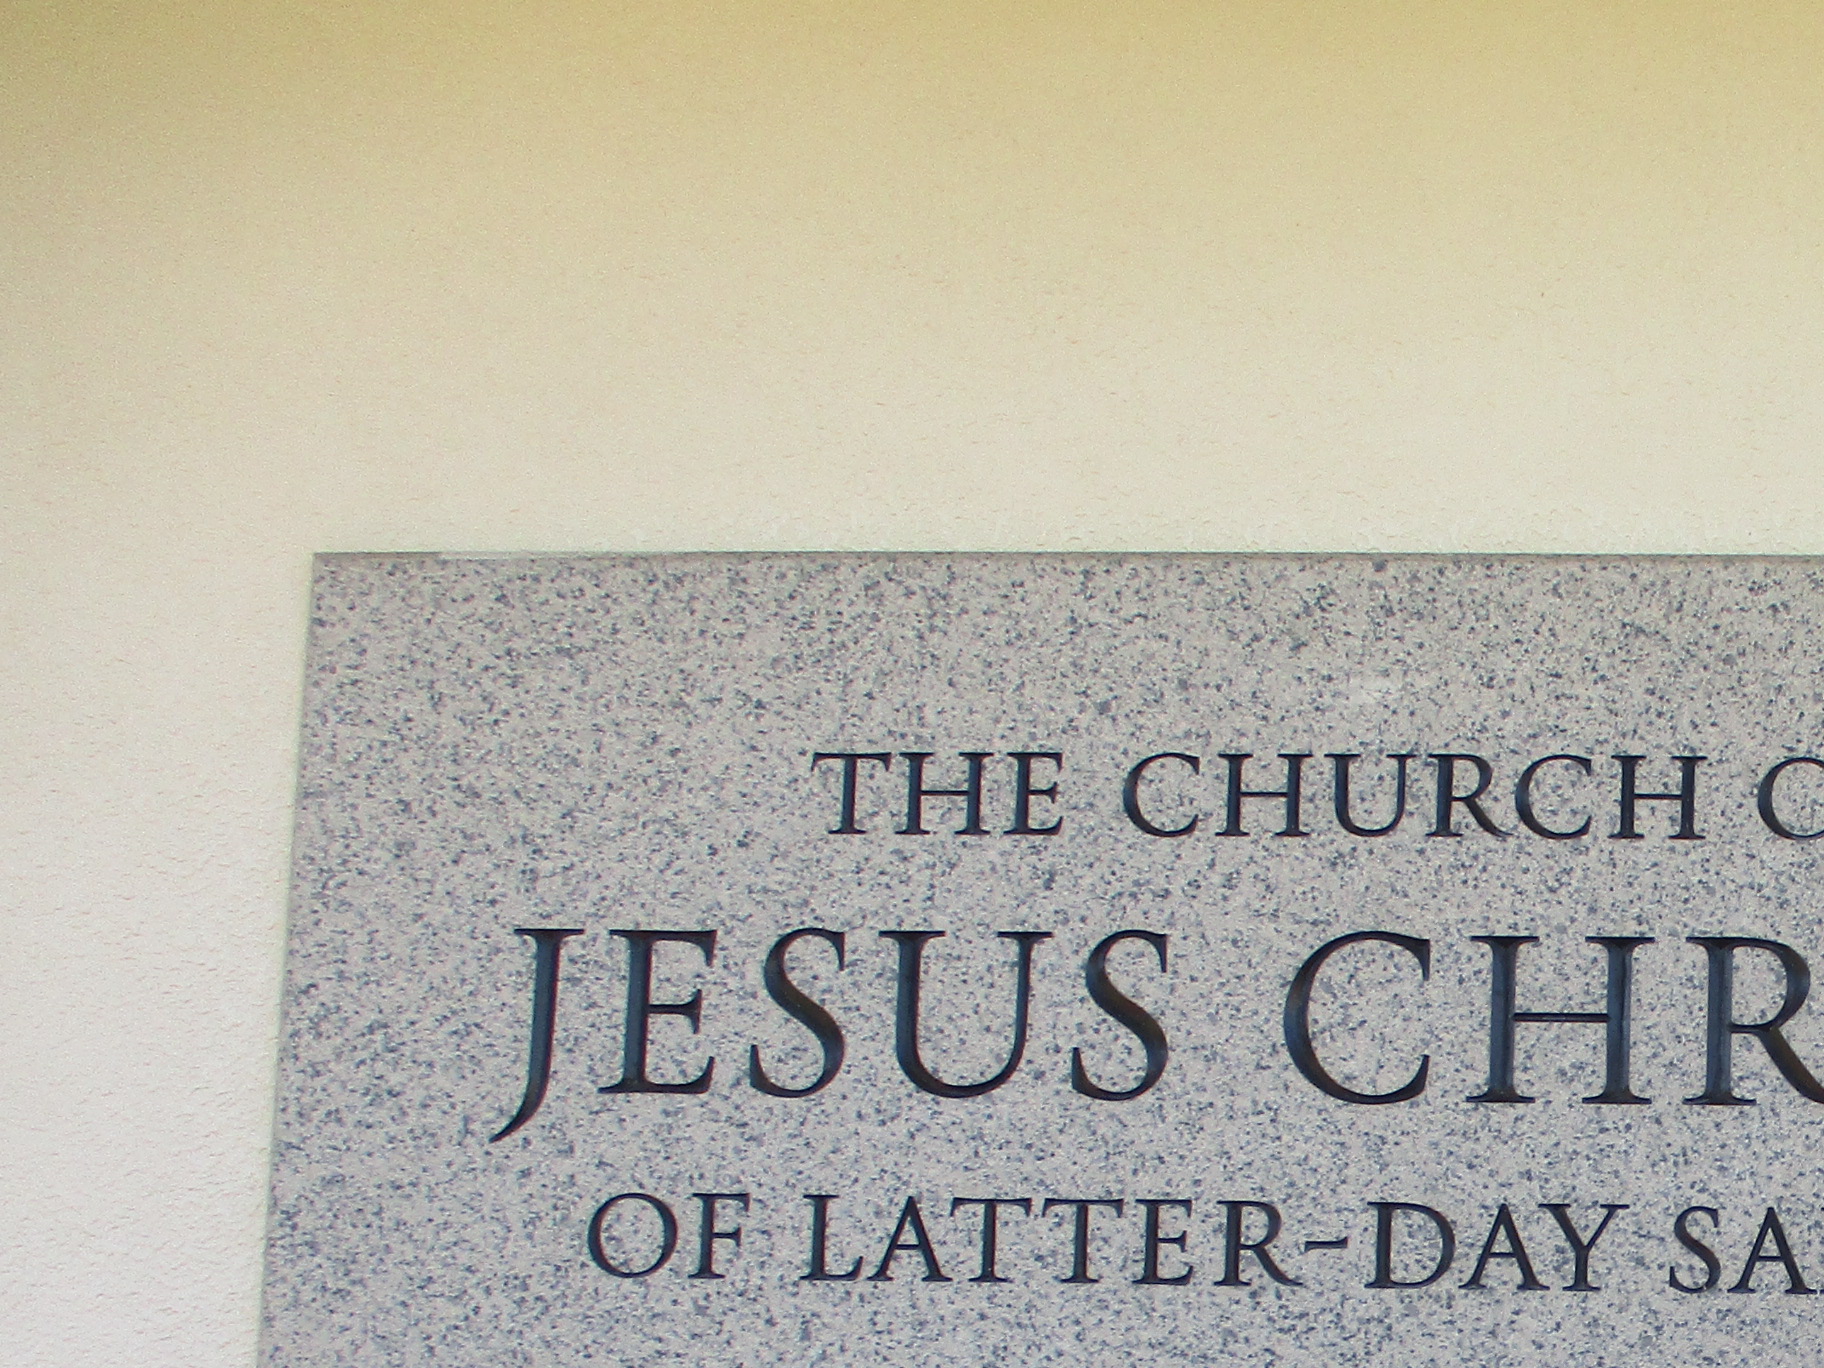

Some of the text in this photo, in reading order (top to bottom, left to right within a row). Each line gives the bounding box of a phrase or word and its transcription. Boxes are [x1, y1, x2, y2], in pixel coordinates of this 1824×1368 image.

[814, 752, 1061, 835] THE
[1124, 753, 1703, 839] CHURCH
[493, 927, 1167, 1140] JESUS
[588, 1193, 749, 1278] OF
[804, 1194, 1629, 1291] LATTER-DAY
